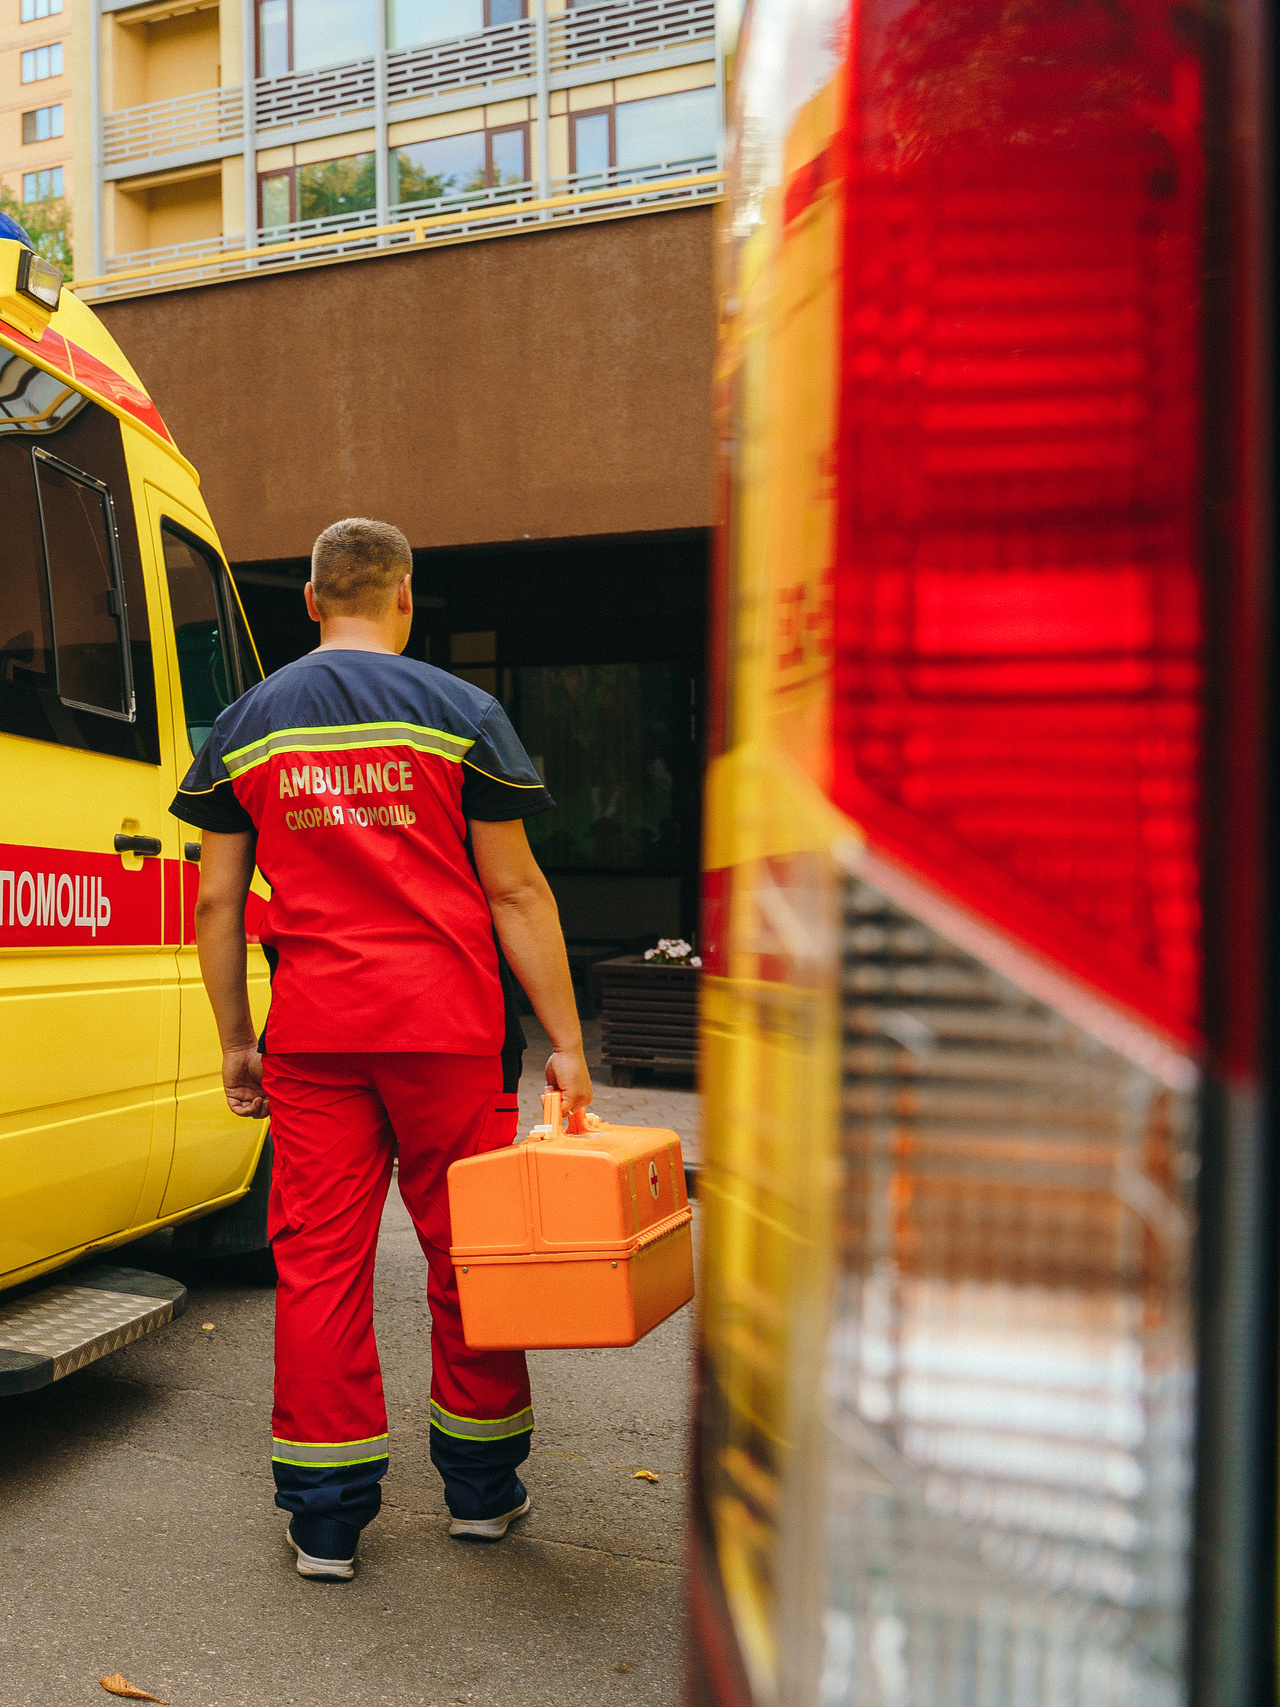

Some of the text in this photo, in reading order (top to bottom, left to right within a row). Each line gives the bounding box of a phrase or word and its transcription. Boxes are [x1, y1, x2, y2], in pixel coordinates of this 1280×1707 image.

[279, 761, 414, 799] AMBULANCE
[285, 804, 417, 831] СКОРАЯ ПОМОЩЬ
